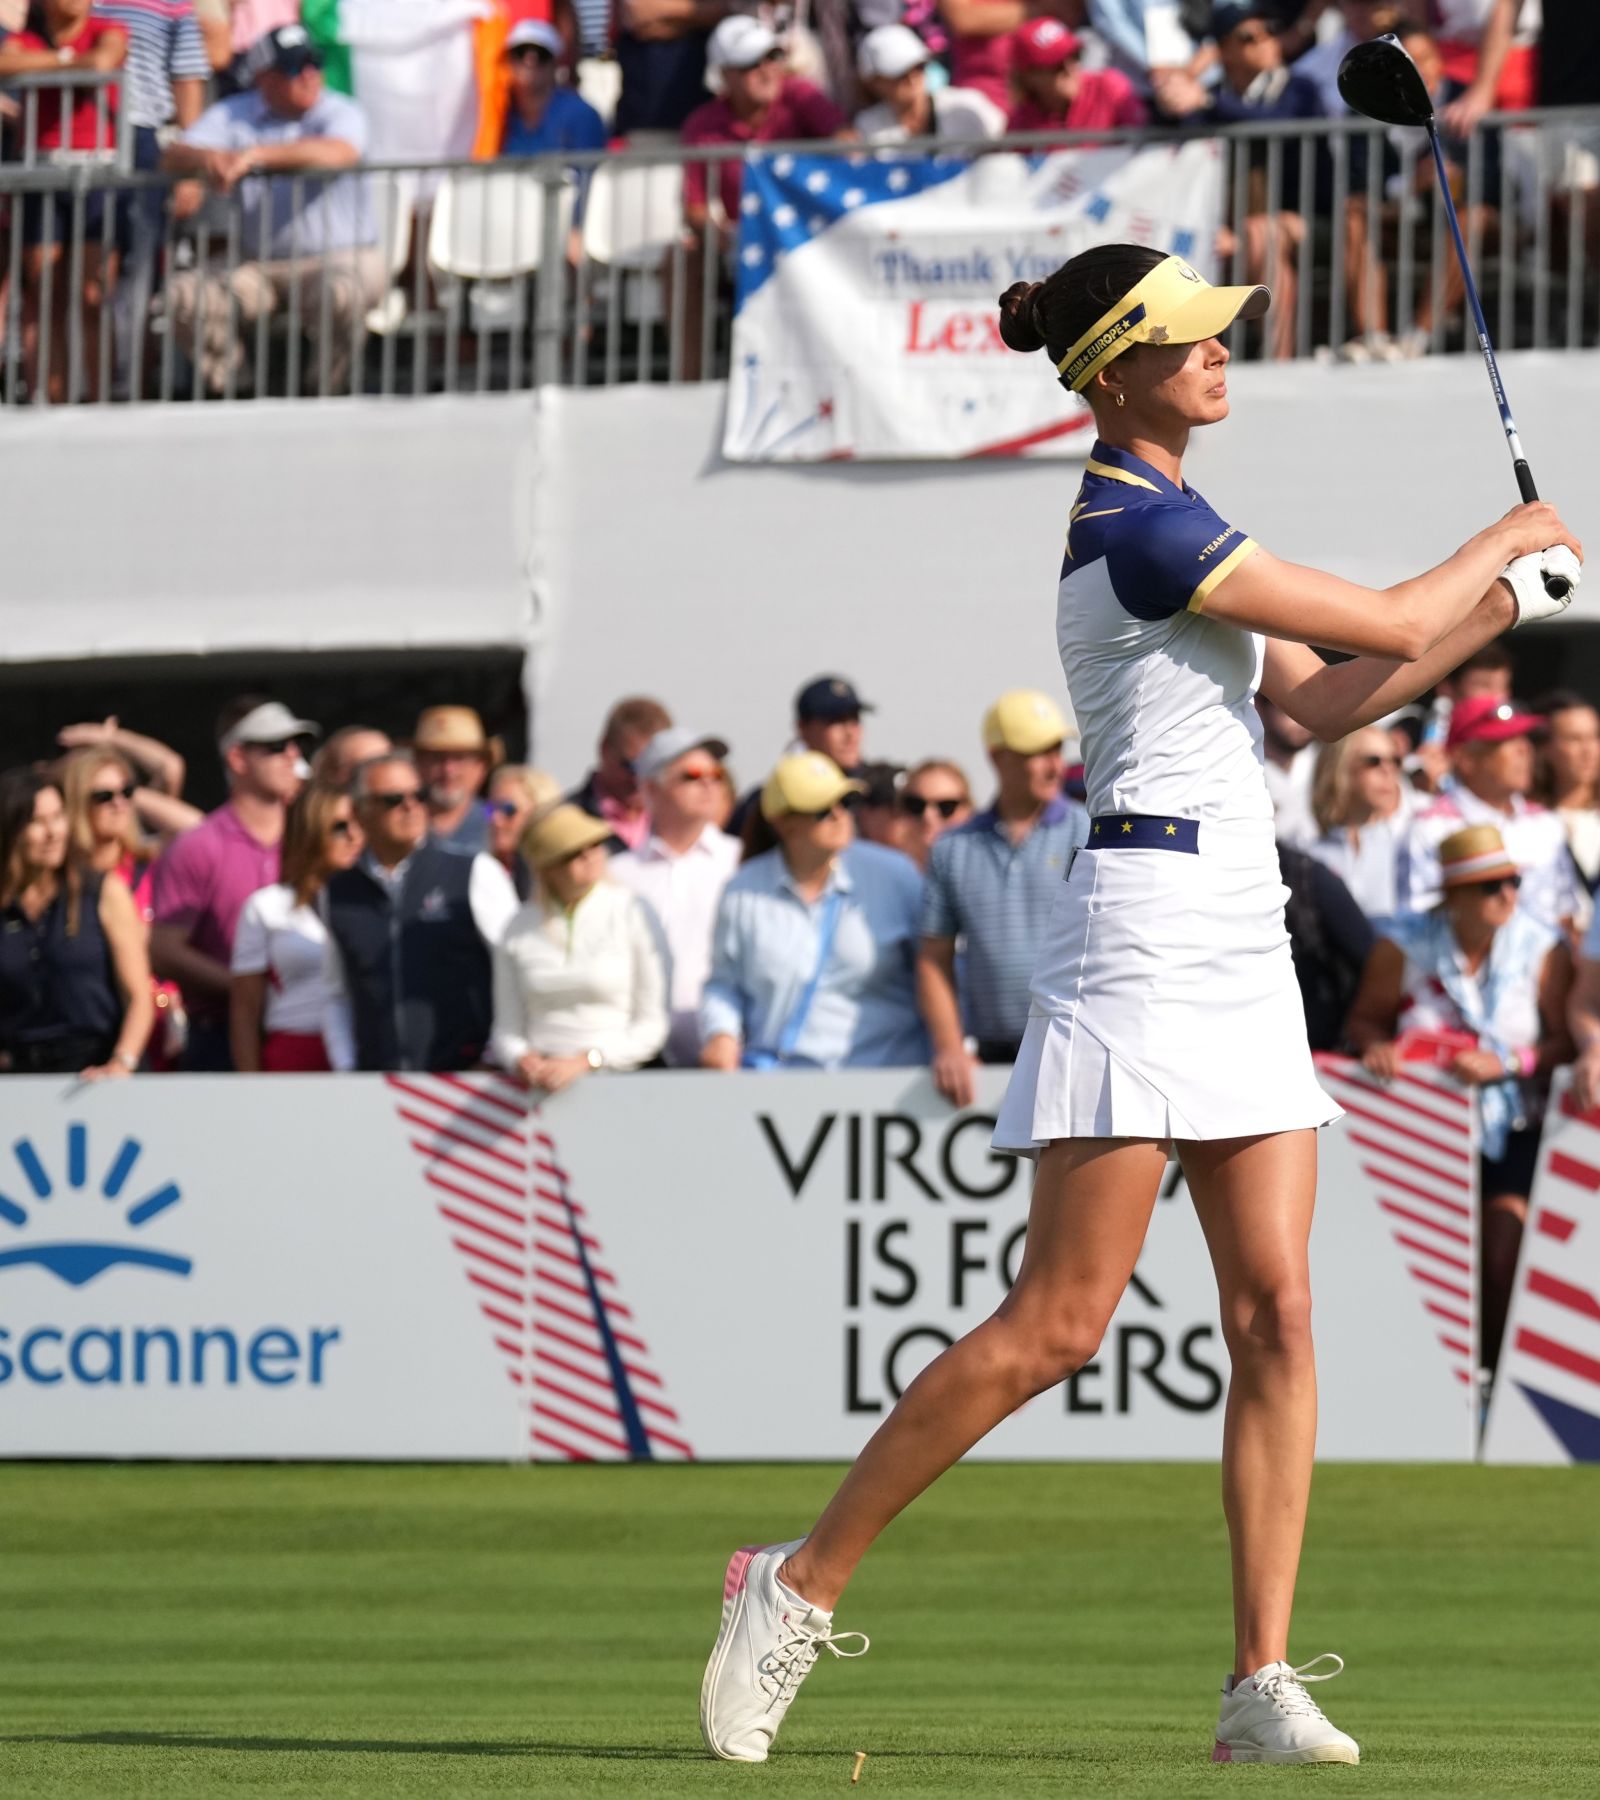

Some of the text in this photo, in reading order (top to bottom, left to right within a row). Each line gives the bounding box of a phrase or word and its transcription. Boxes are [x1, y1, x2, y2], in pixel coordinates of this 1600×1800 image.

[876, 247, 993, 283] Thank
[1067, 323, 1125, 378] TEAM EUROPE
[1202, 534, 1227, 556] TEAM
[845, 1220, 918, 1307] IS
